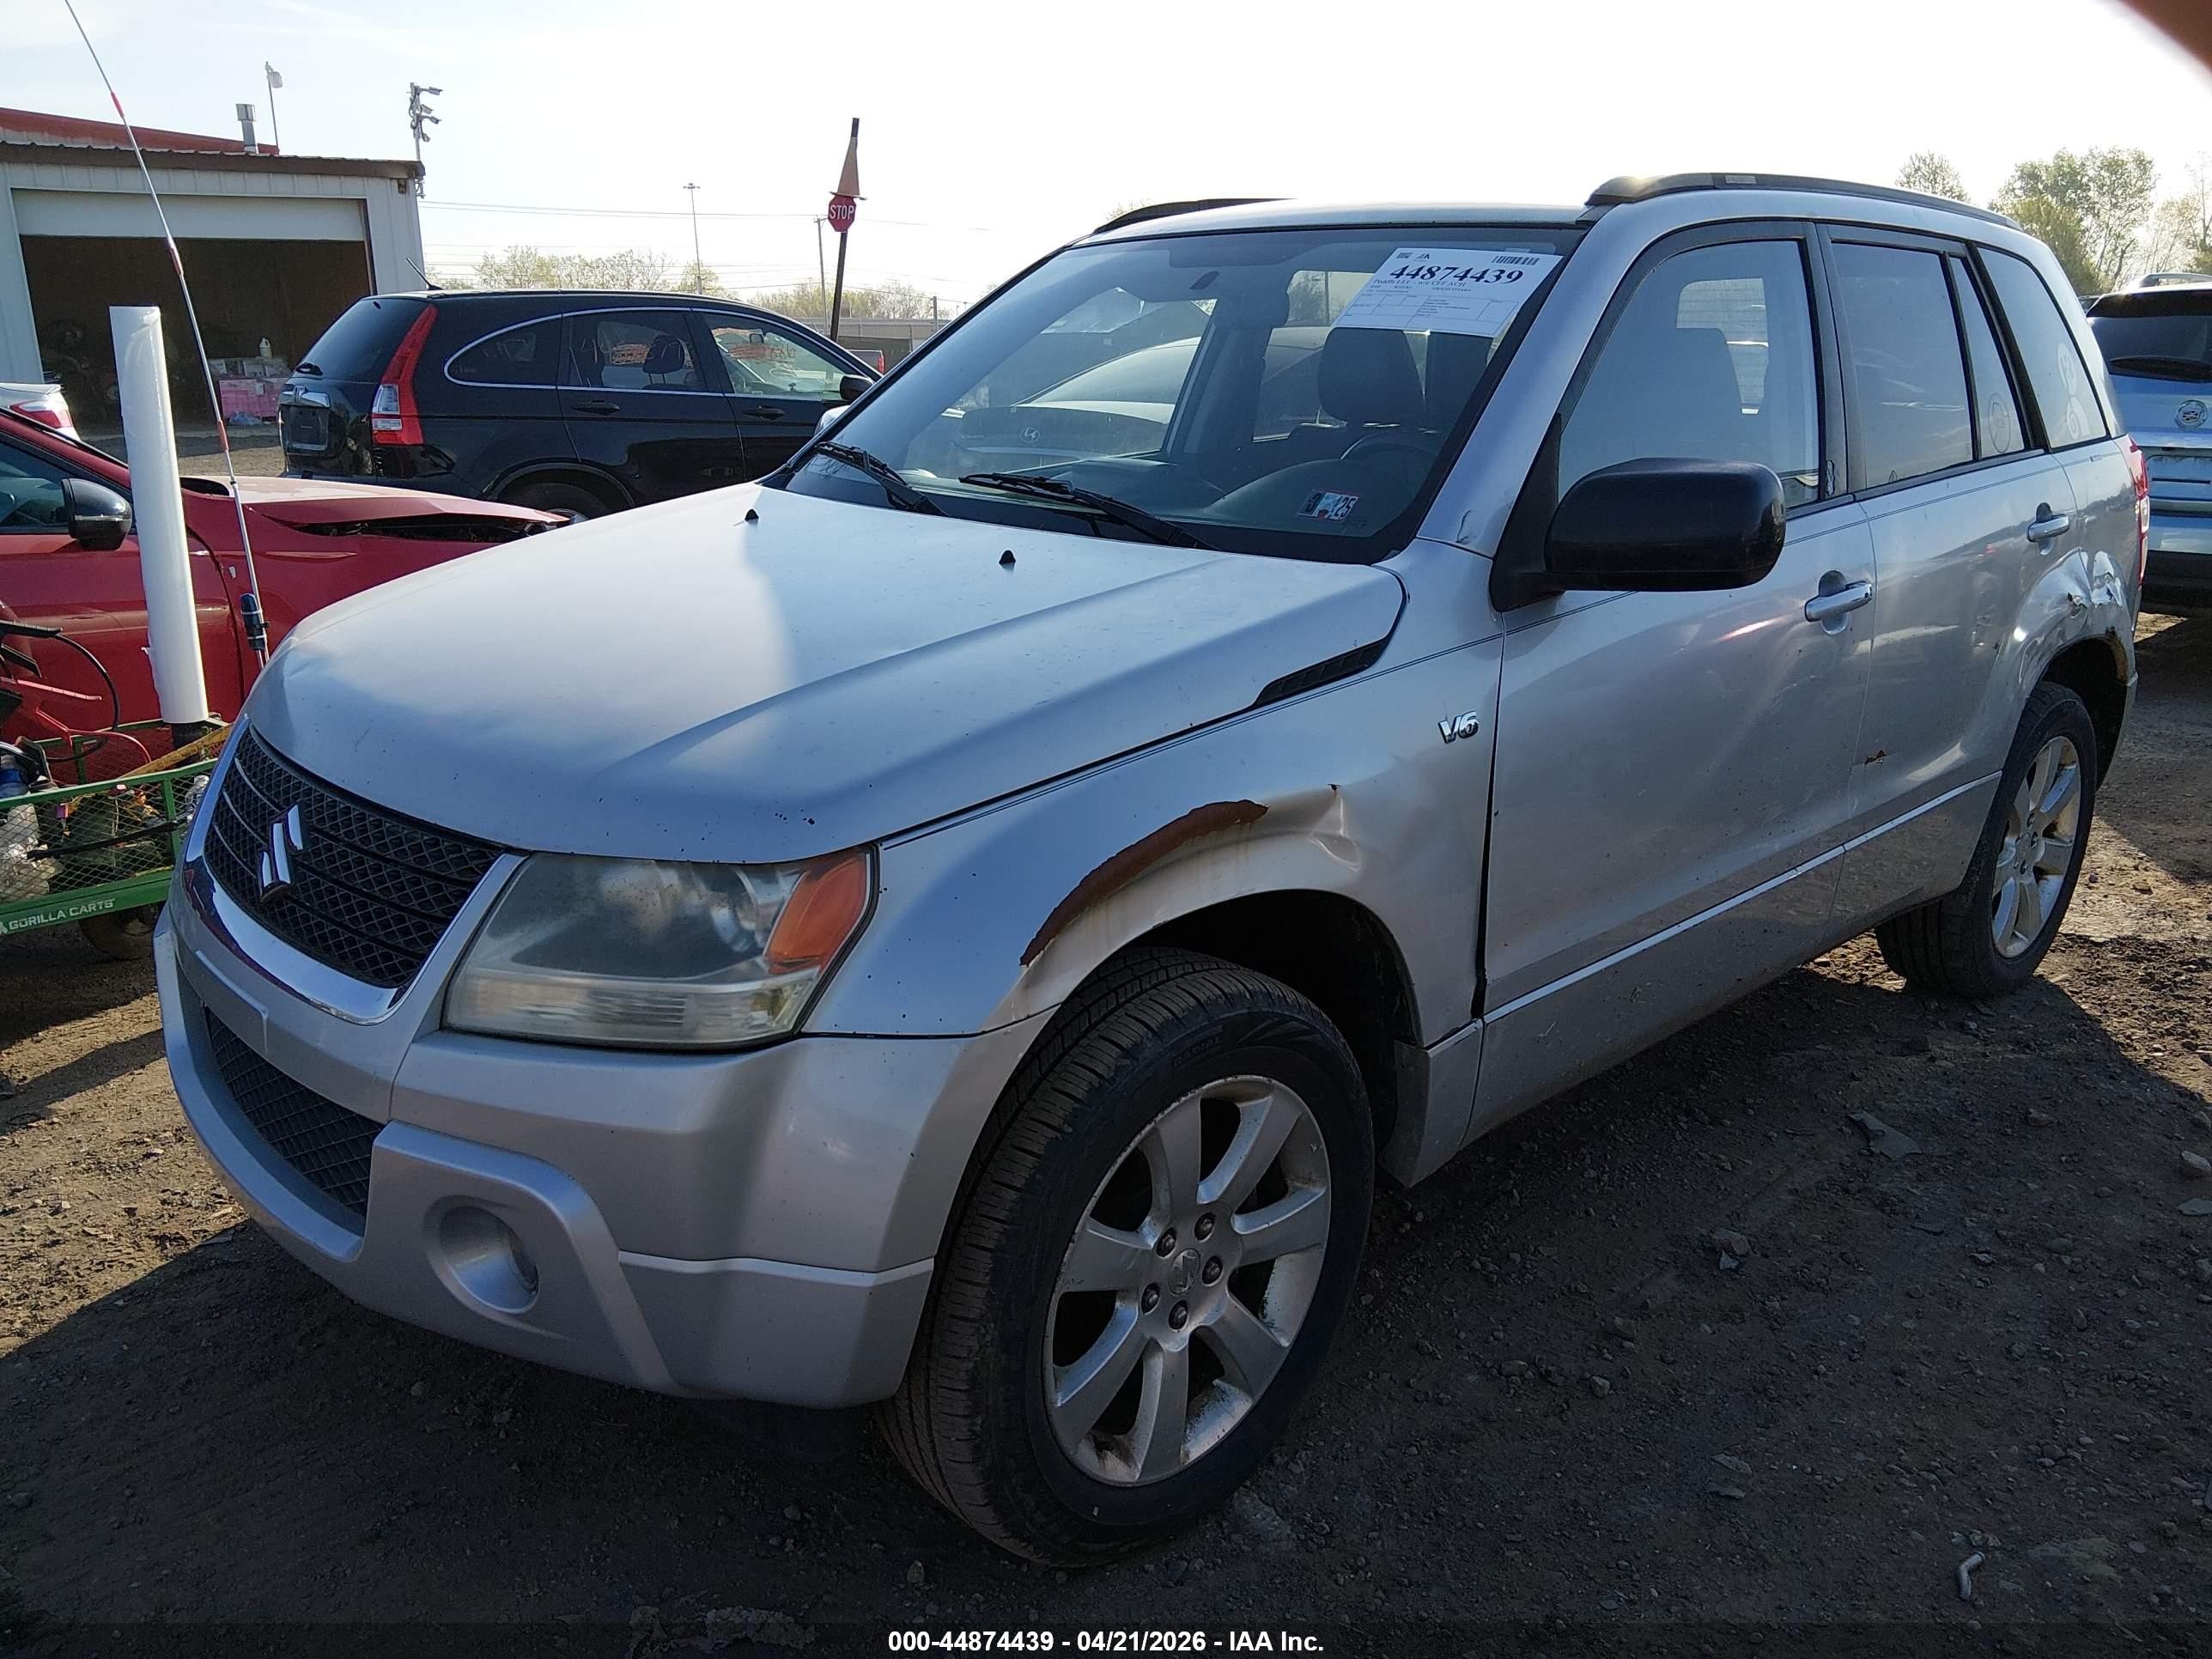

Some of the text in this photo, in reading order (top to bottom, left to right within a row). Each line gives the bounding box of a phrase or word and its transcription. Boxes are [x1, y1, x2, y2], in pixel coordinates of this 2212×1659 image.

[830, 204, 854, 220] STOP
[1389, 264, 1523, 284] 44874439
[1438, 711, 1479, 744] V6
[9, 899, 113, 930] GORILLA CARTS
